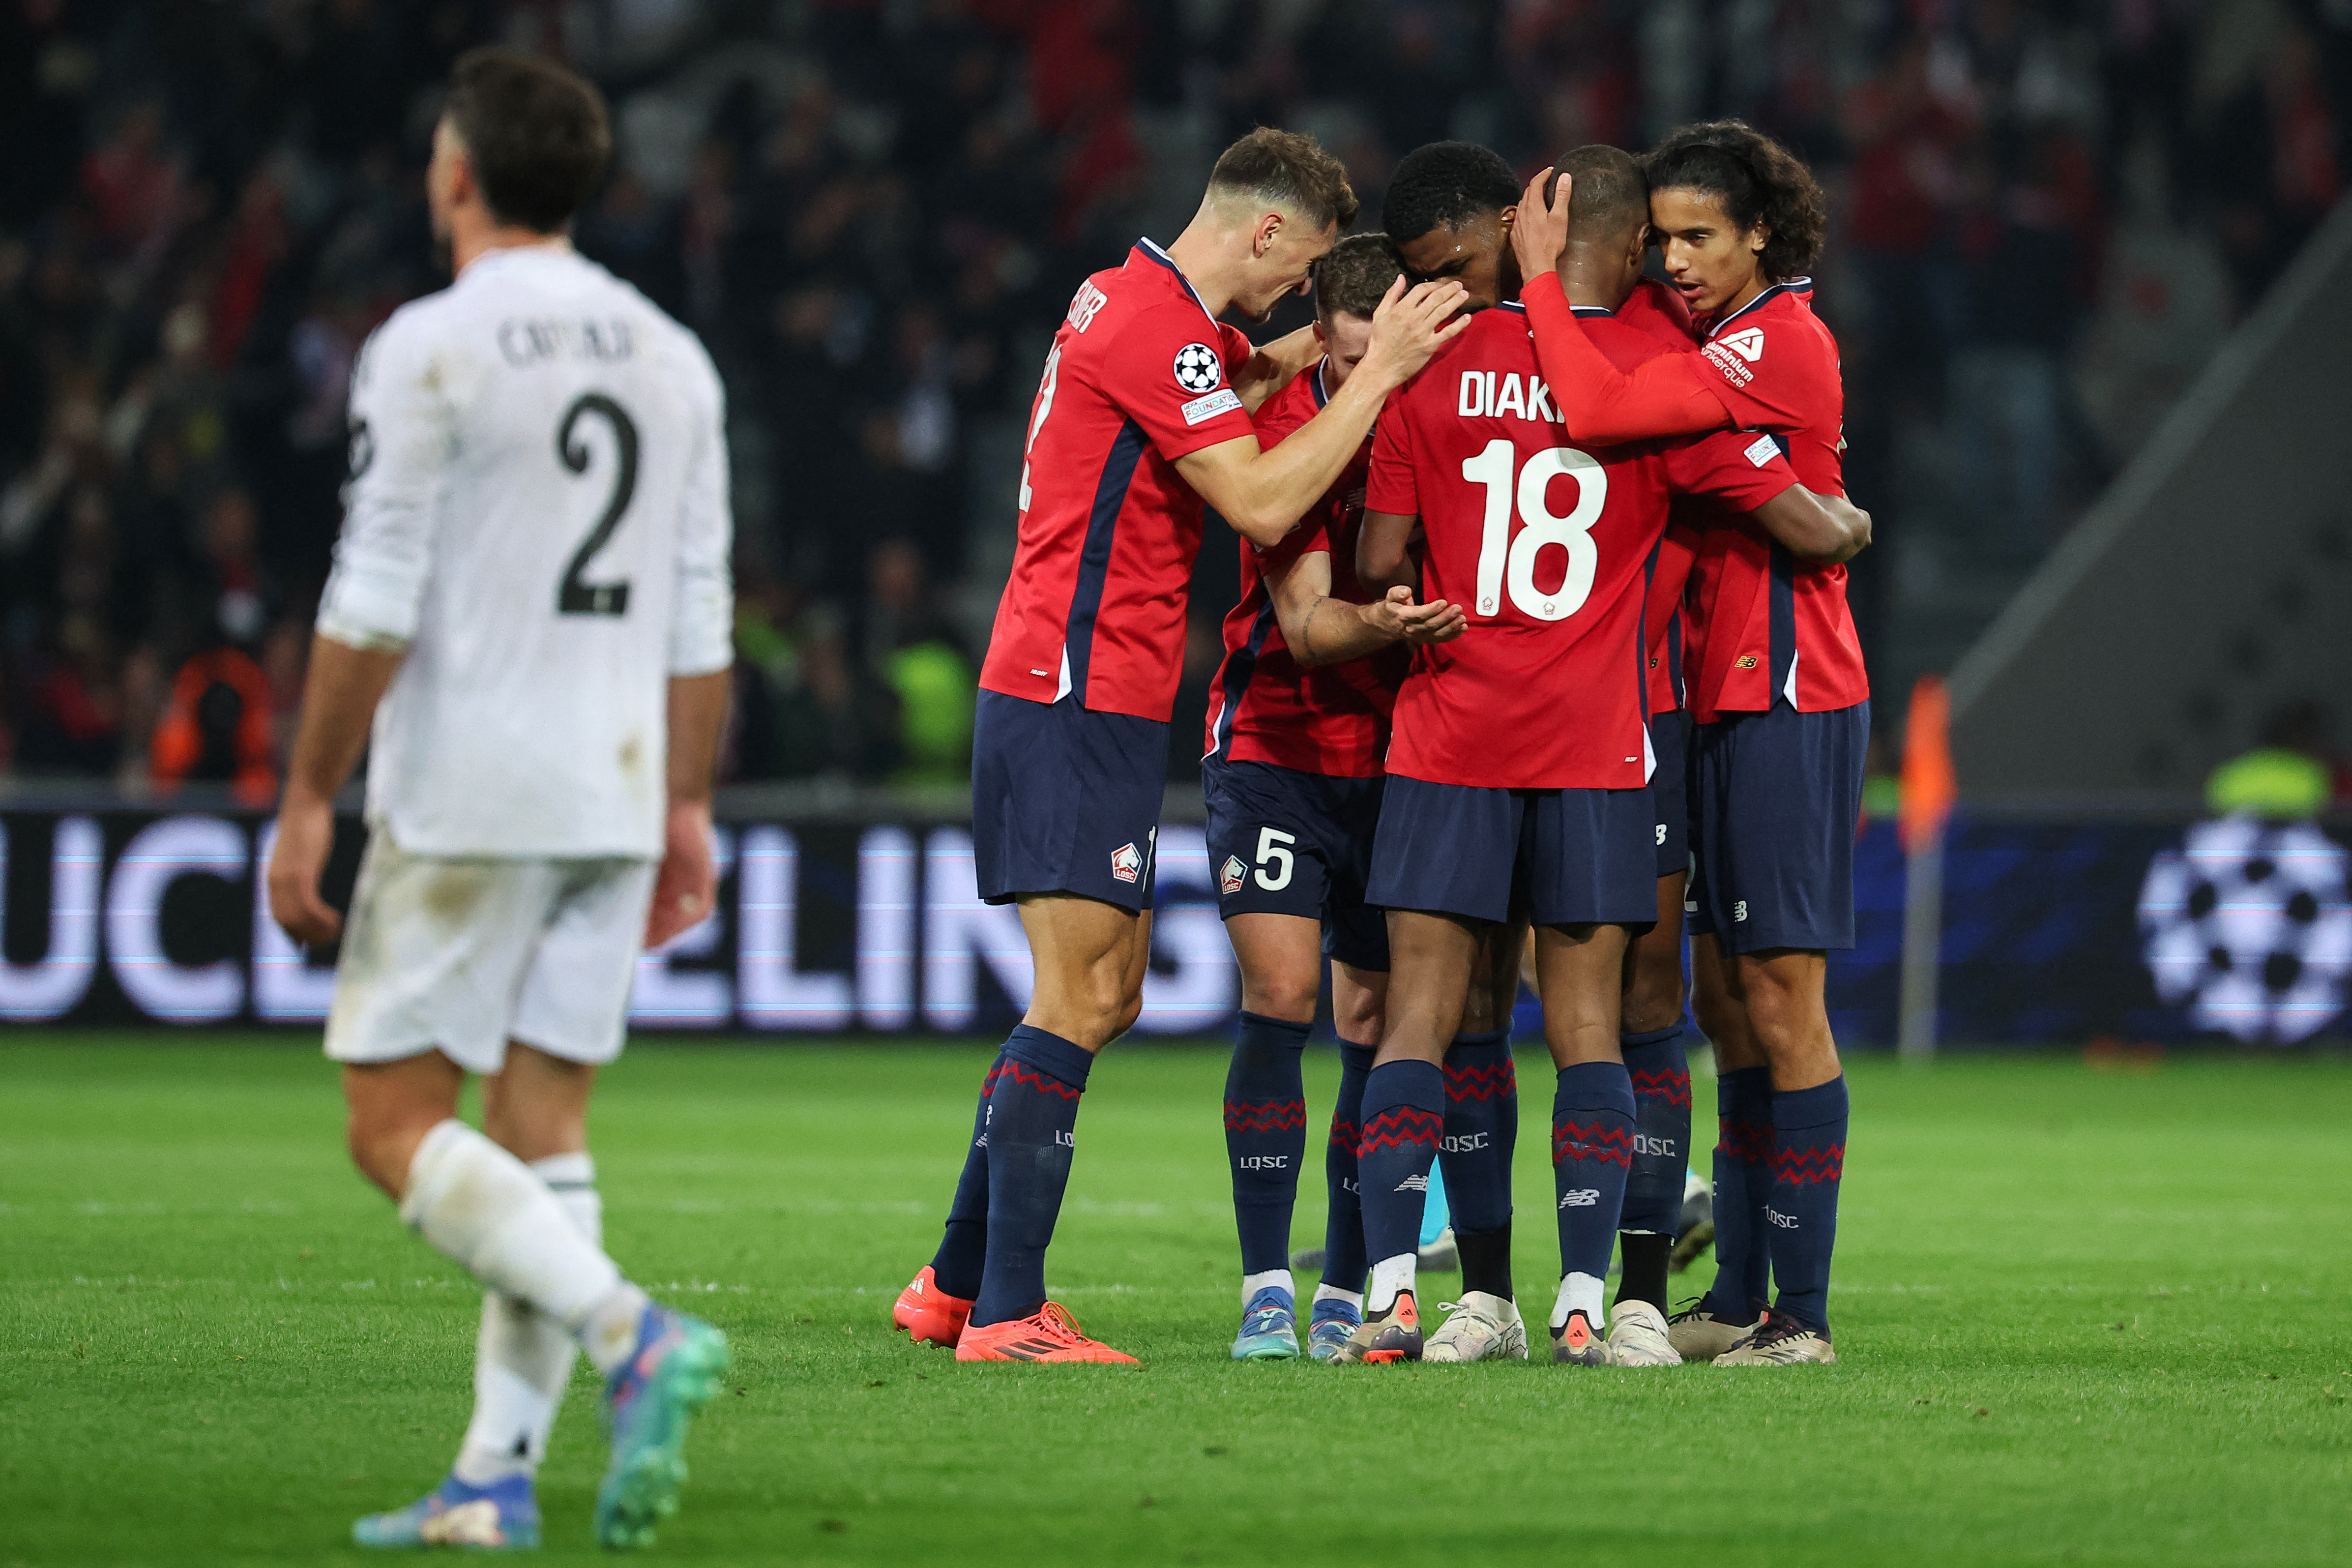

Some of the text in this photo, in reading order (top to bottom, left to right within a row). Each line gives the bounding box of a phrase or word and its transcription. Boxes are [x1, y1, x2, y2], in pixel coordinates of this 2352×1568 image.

[1701, 347, 1745, 388] unkerque
[1184, 401, 1198, 411] UEFA
[1458, 371, 1565, 423] DIAK
[557, 393, 642, 617] 2
[1462, 439, 1608, 621] 18
[1254, 827, 1295, 891] 5
[1116, 869, 1135, 880] LOSC
[1224, 882, 1239, 891] LOSC
[1056, 1129, 1075, 1148] LO
[1633, 1133, 1676, 1157] OSC
[1240, 1155, 1288, 1171] LOSC
